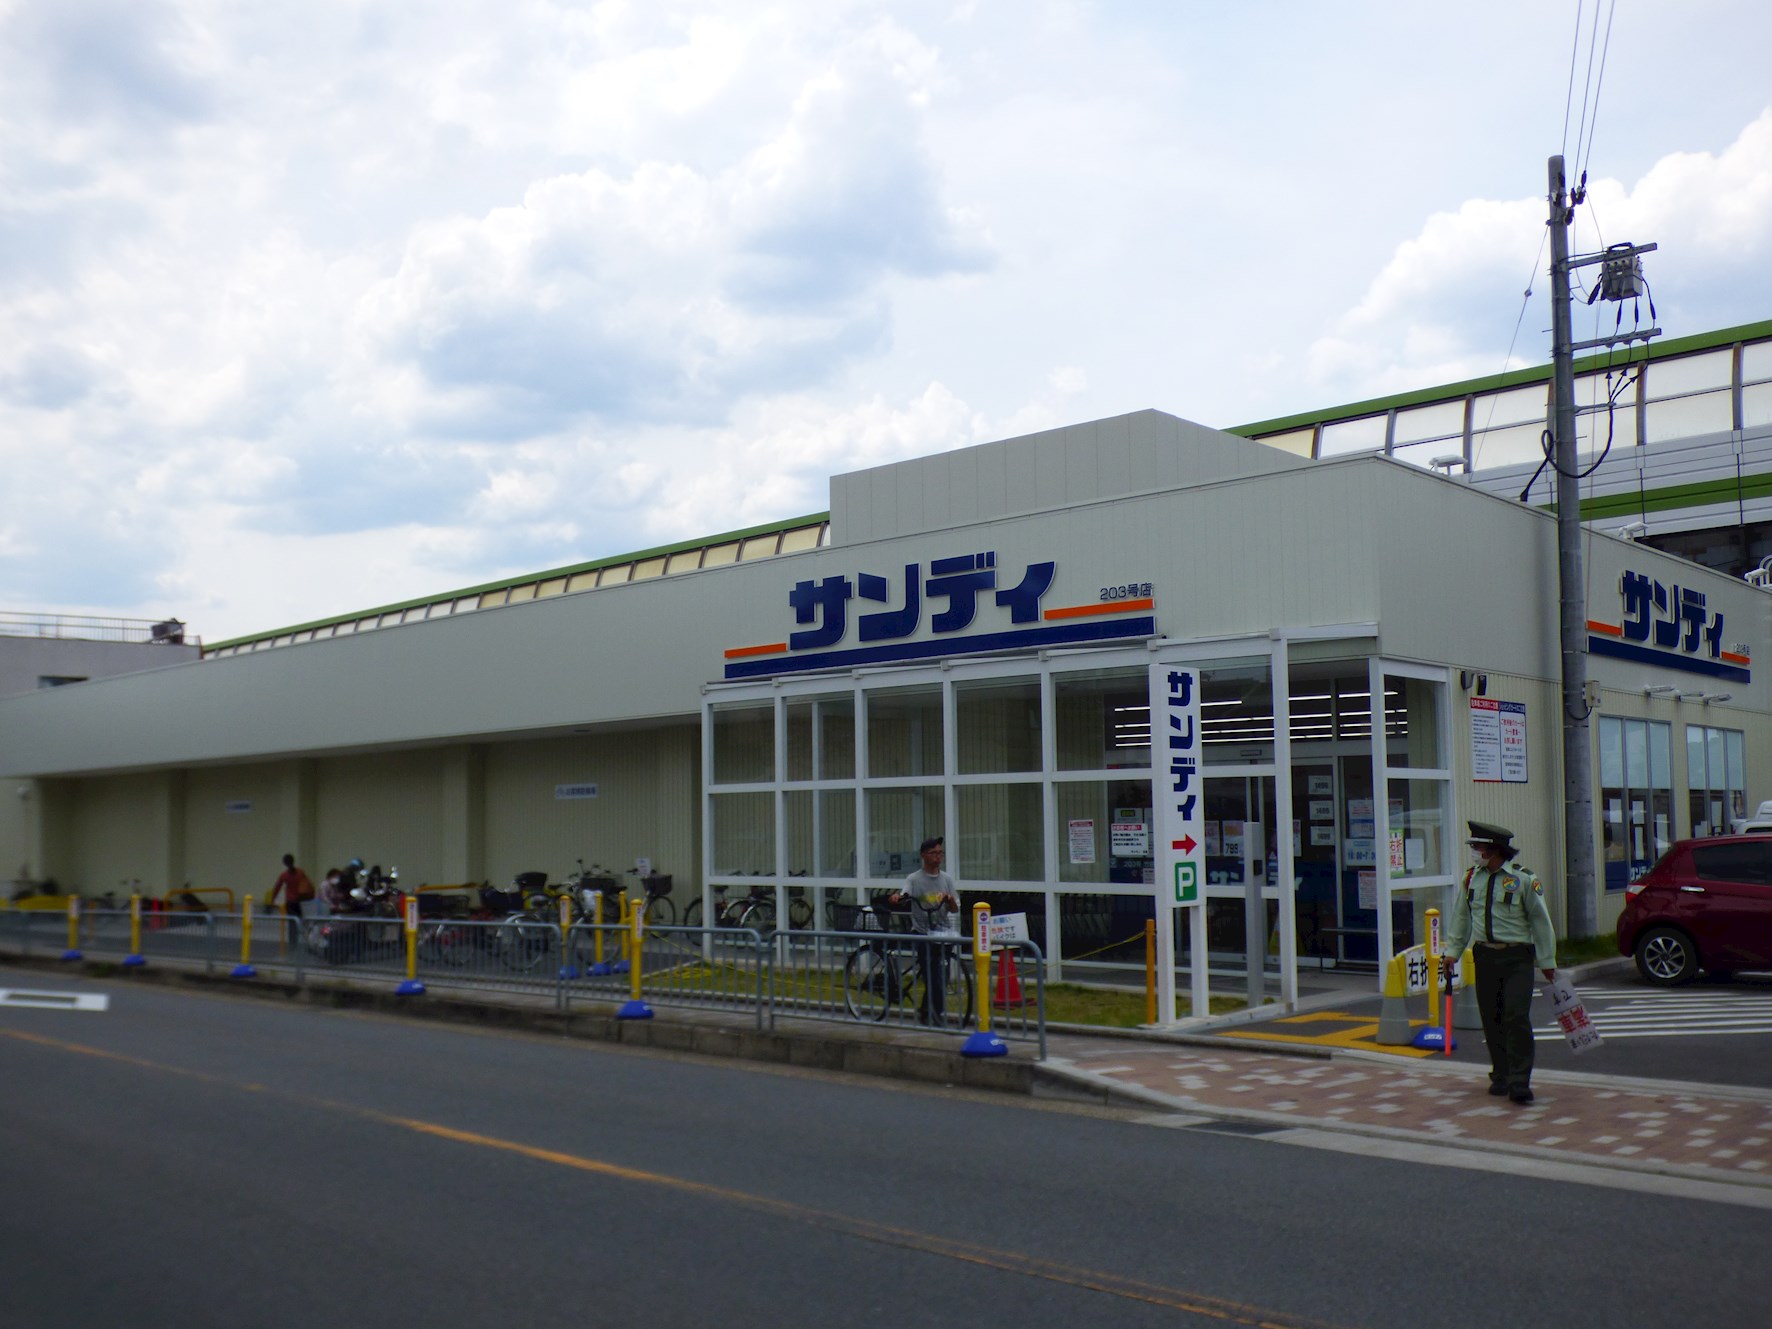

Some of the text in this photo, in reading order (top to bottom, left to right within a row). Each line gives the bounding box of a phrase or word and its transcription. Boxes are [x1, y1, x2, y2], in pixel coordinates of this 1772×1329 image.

[789, 550, 1056, 650] サンディ
[1100, 582, 1153, 600] 203号店
[1621, 569, 1724, 658] サンディ
[1168, 671, 1196, 821] サンディ
[1179, 867, 1195, 897] P
